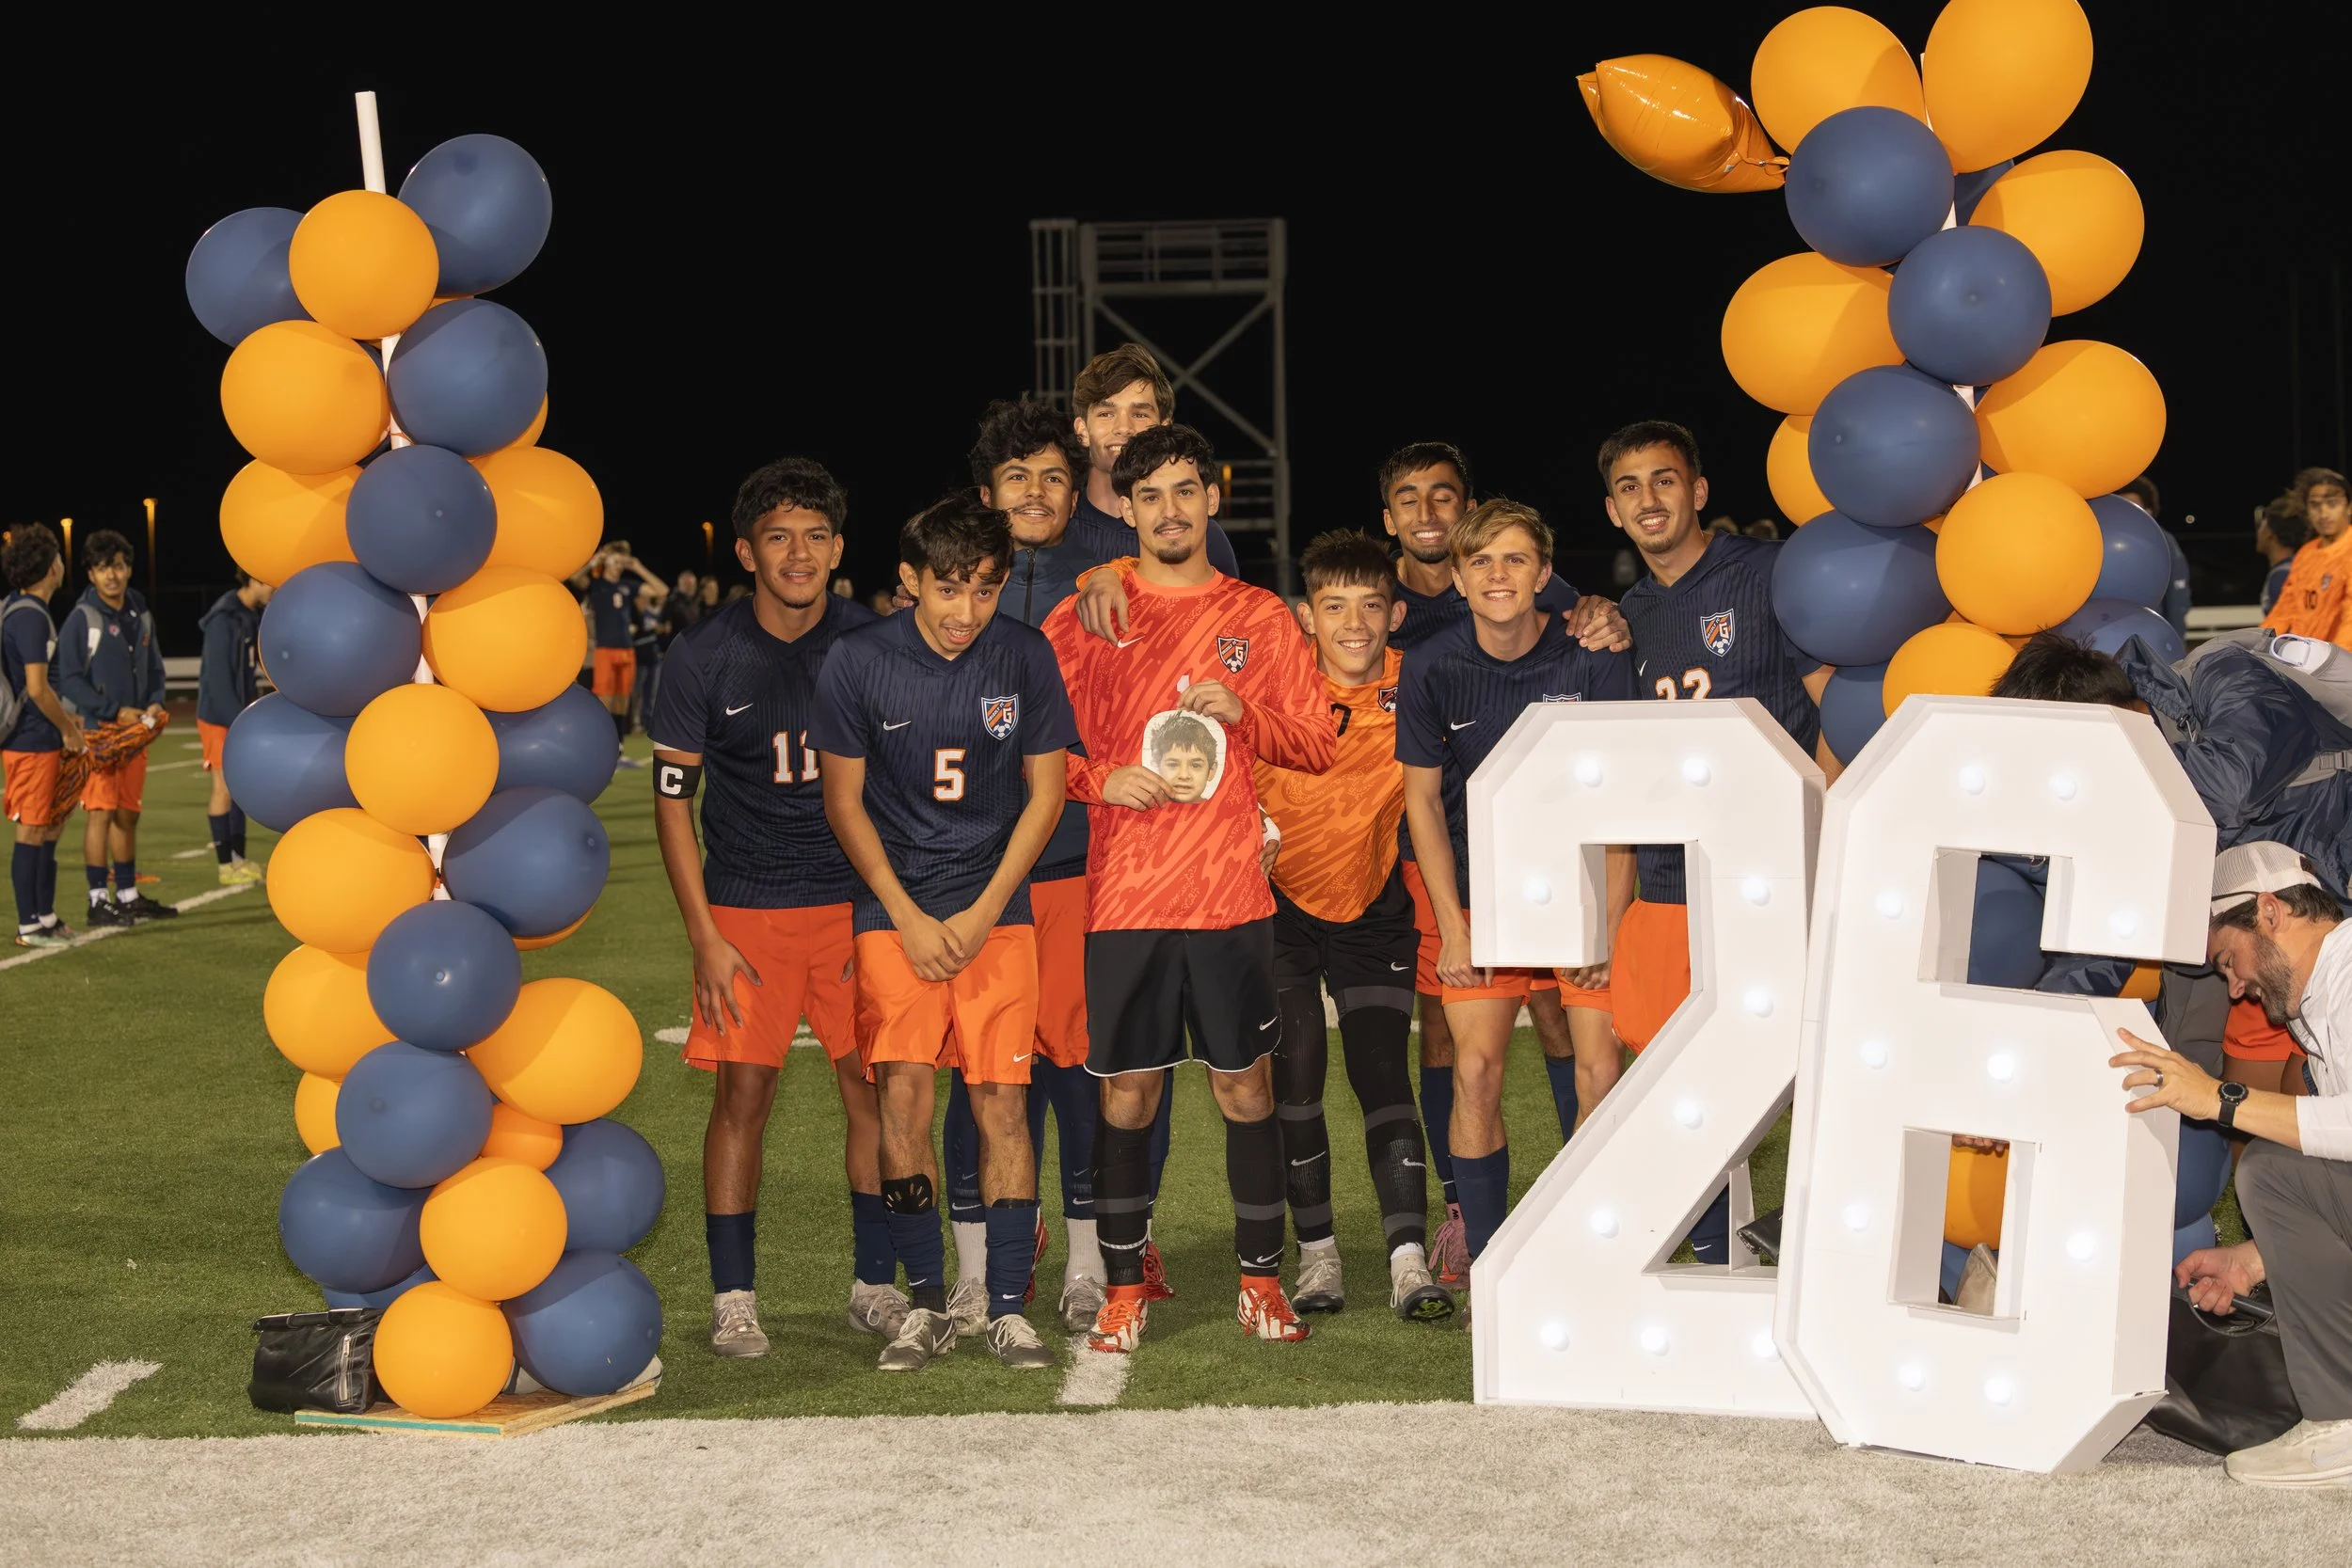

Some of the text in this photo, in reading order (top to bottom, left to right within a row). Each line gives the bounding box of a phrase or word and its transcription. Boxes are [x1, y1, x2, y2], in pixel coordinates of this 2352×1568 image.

[1719, 622, 1729, 640] G
[1235, 646, 1244, 662] G
[1002, 706, 1012, 724] G
[772, 730, 819, 784] 11
[660, 766, 684, 795] C
[933, 749, 966, 801] 5
